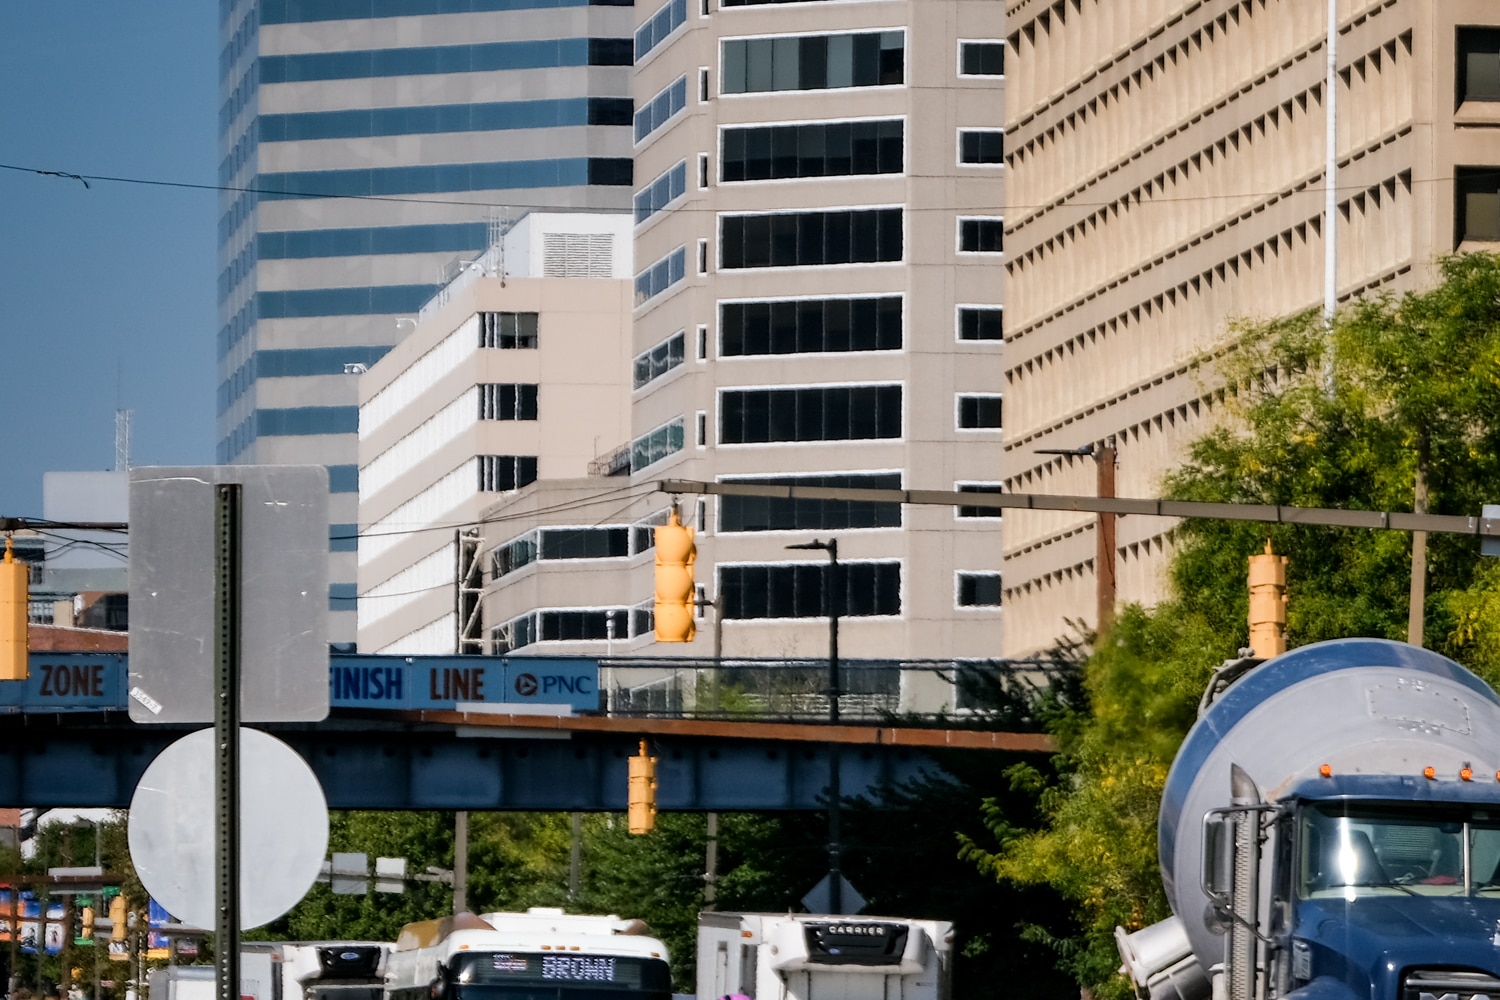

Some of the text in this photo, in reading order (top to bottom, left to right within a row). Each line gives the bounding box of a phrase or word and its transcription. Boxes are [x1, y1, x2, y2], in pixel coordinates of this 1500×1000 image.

[39, 664, 104, 696] ZONE
[430, 668, 485, 700] LINE
[542, 675, 592, 695] PNC
[829, 926, 885, 935] CARRIER
